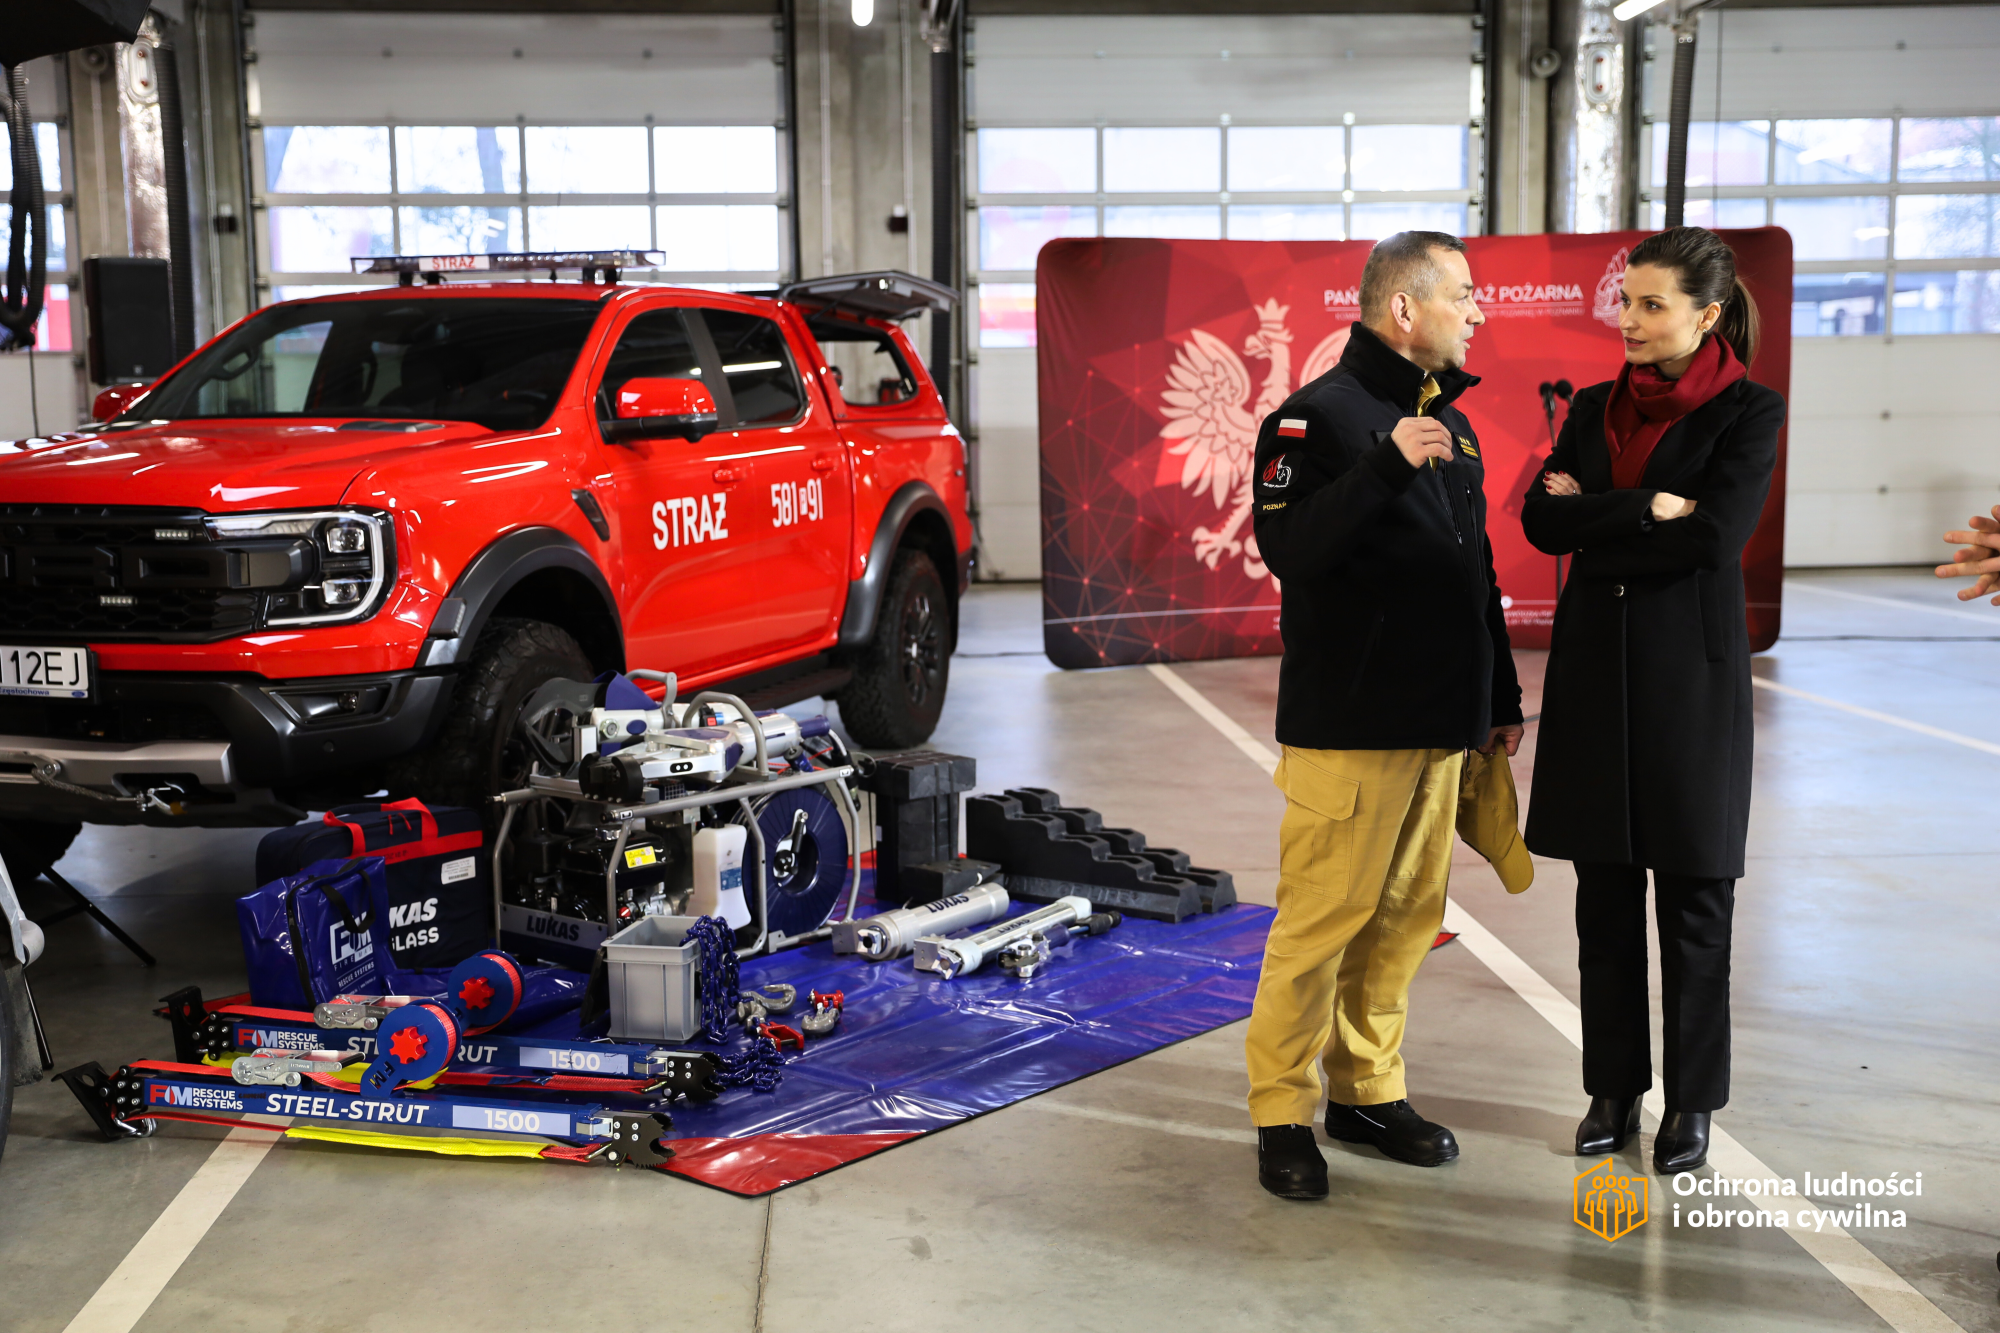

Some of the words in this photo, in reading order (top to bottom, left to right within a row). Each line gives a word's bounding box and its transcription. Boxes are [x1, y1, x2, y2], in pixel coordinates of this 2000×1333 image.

[1498, 281, 1584, 303] POŻARNA
[0, 650, 80, 686] 12EJ
[526, 916, 580, 942] LUKAS
[277, 1031, 318, 1043] RESCUE
[278, 1039, 325, 1051] SYSTEMS
[549, 1050, 600, 1071] 1500
[192, 1087, 236, 1100] RESCUE
[192, 1098, 244, 1110] SYSTEMS
[266, 1093, 430, 1124] STEEL-STRUT
[484, 1110, 540, 1132] 1500
